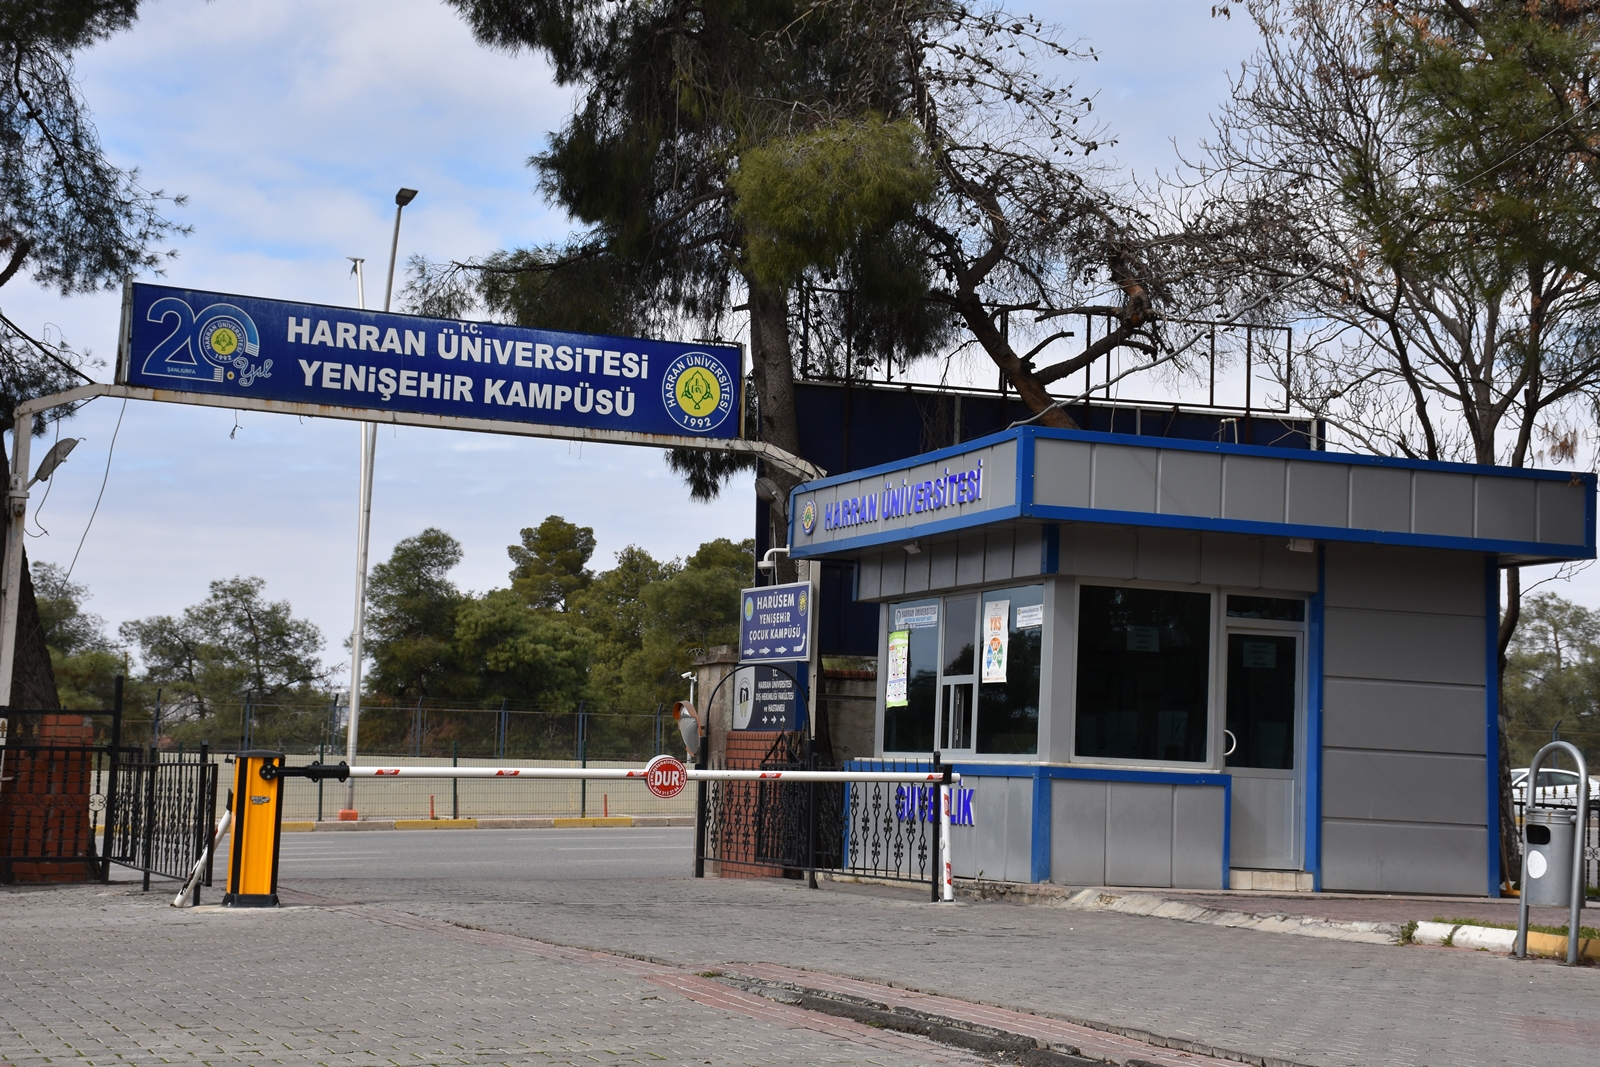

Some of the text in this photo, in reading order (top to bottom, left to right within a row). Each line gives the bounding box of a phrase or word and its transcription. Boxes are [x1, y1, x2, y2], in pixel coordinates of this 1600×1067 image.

[205, 324, 217, 350] HARRAN
[287, 316, 426, 357] HARRAN
[458, 322, 483, 335] T.C.
[214, 353, 232, 361] 1992
[665, 360, 686, 408] HARRAN
[484, 378, 635, 417] KAMPÜSÜ
[683, 415, 712, 428] 1992
[824, 492, 880, 531] HARRAN
[756, 591, 795, 610] HARÜSEM
[749, 624, 801, 644] ÇOCUK KAMPÜSÜ
[654, 770, 680, 786] DUR
